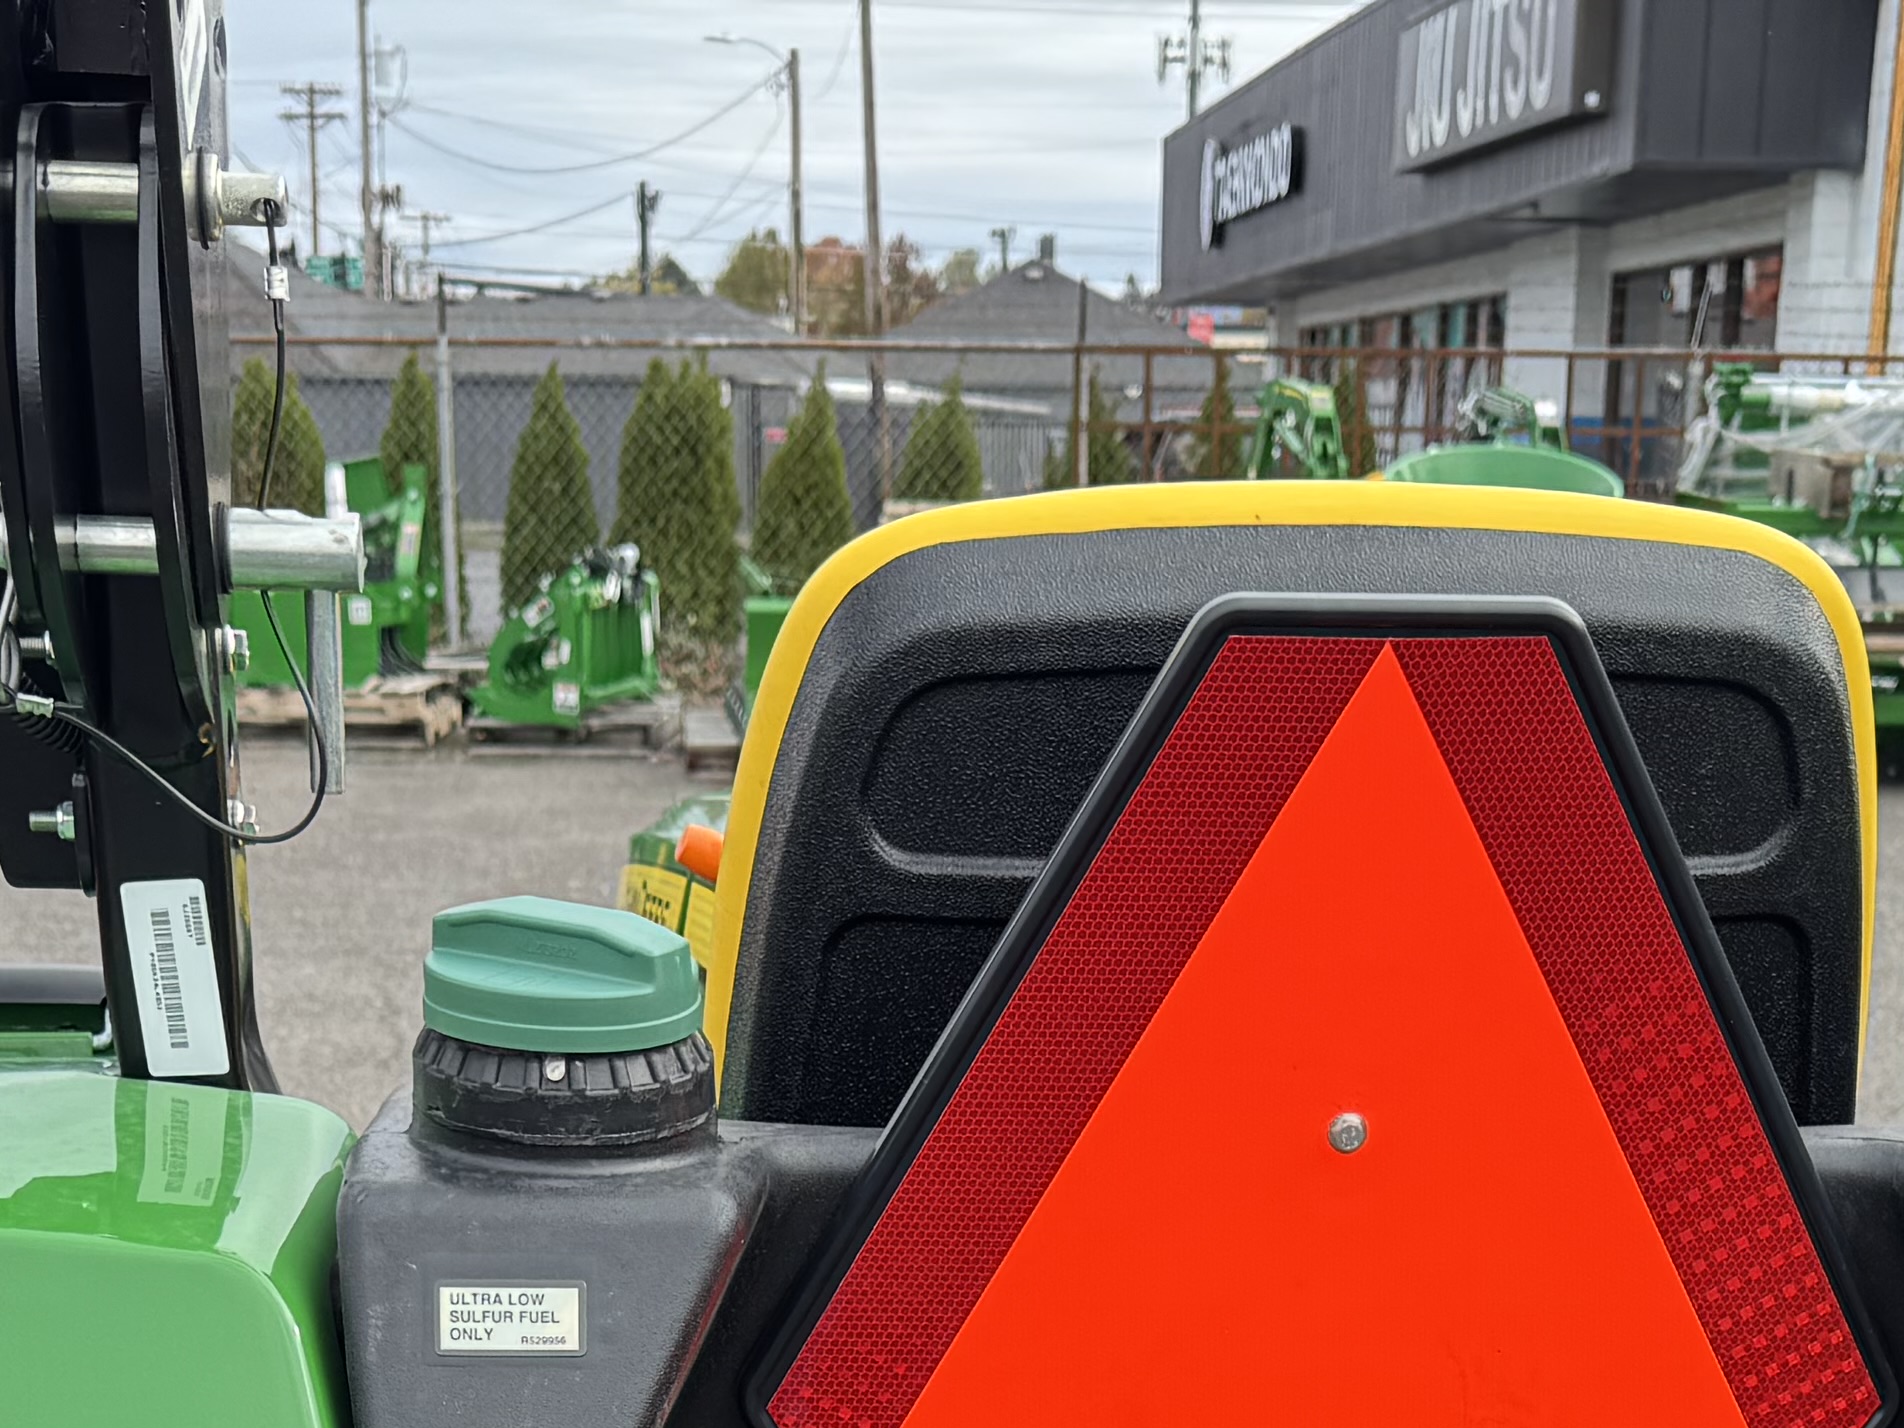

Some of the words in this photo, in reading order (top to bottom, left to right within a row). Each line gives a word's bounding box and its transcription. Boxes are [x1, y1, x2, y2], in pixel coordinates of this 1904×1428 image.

[1215, 121, 1293, 222] TAEKWONDO
[449, 1292, 503, 1306] ULTRA
[508, 1293, 545, 1306] LOW
[449, 1310, 514, 1324] SULFUR
[519, 1310, 560, 1324] FUEL
[449, 1327, 494, 1341] ONLY
